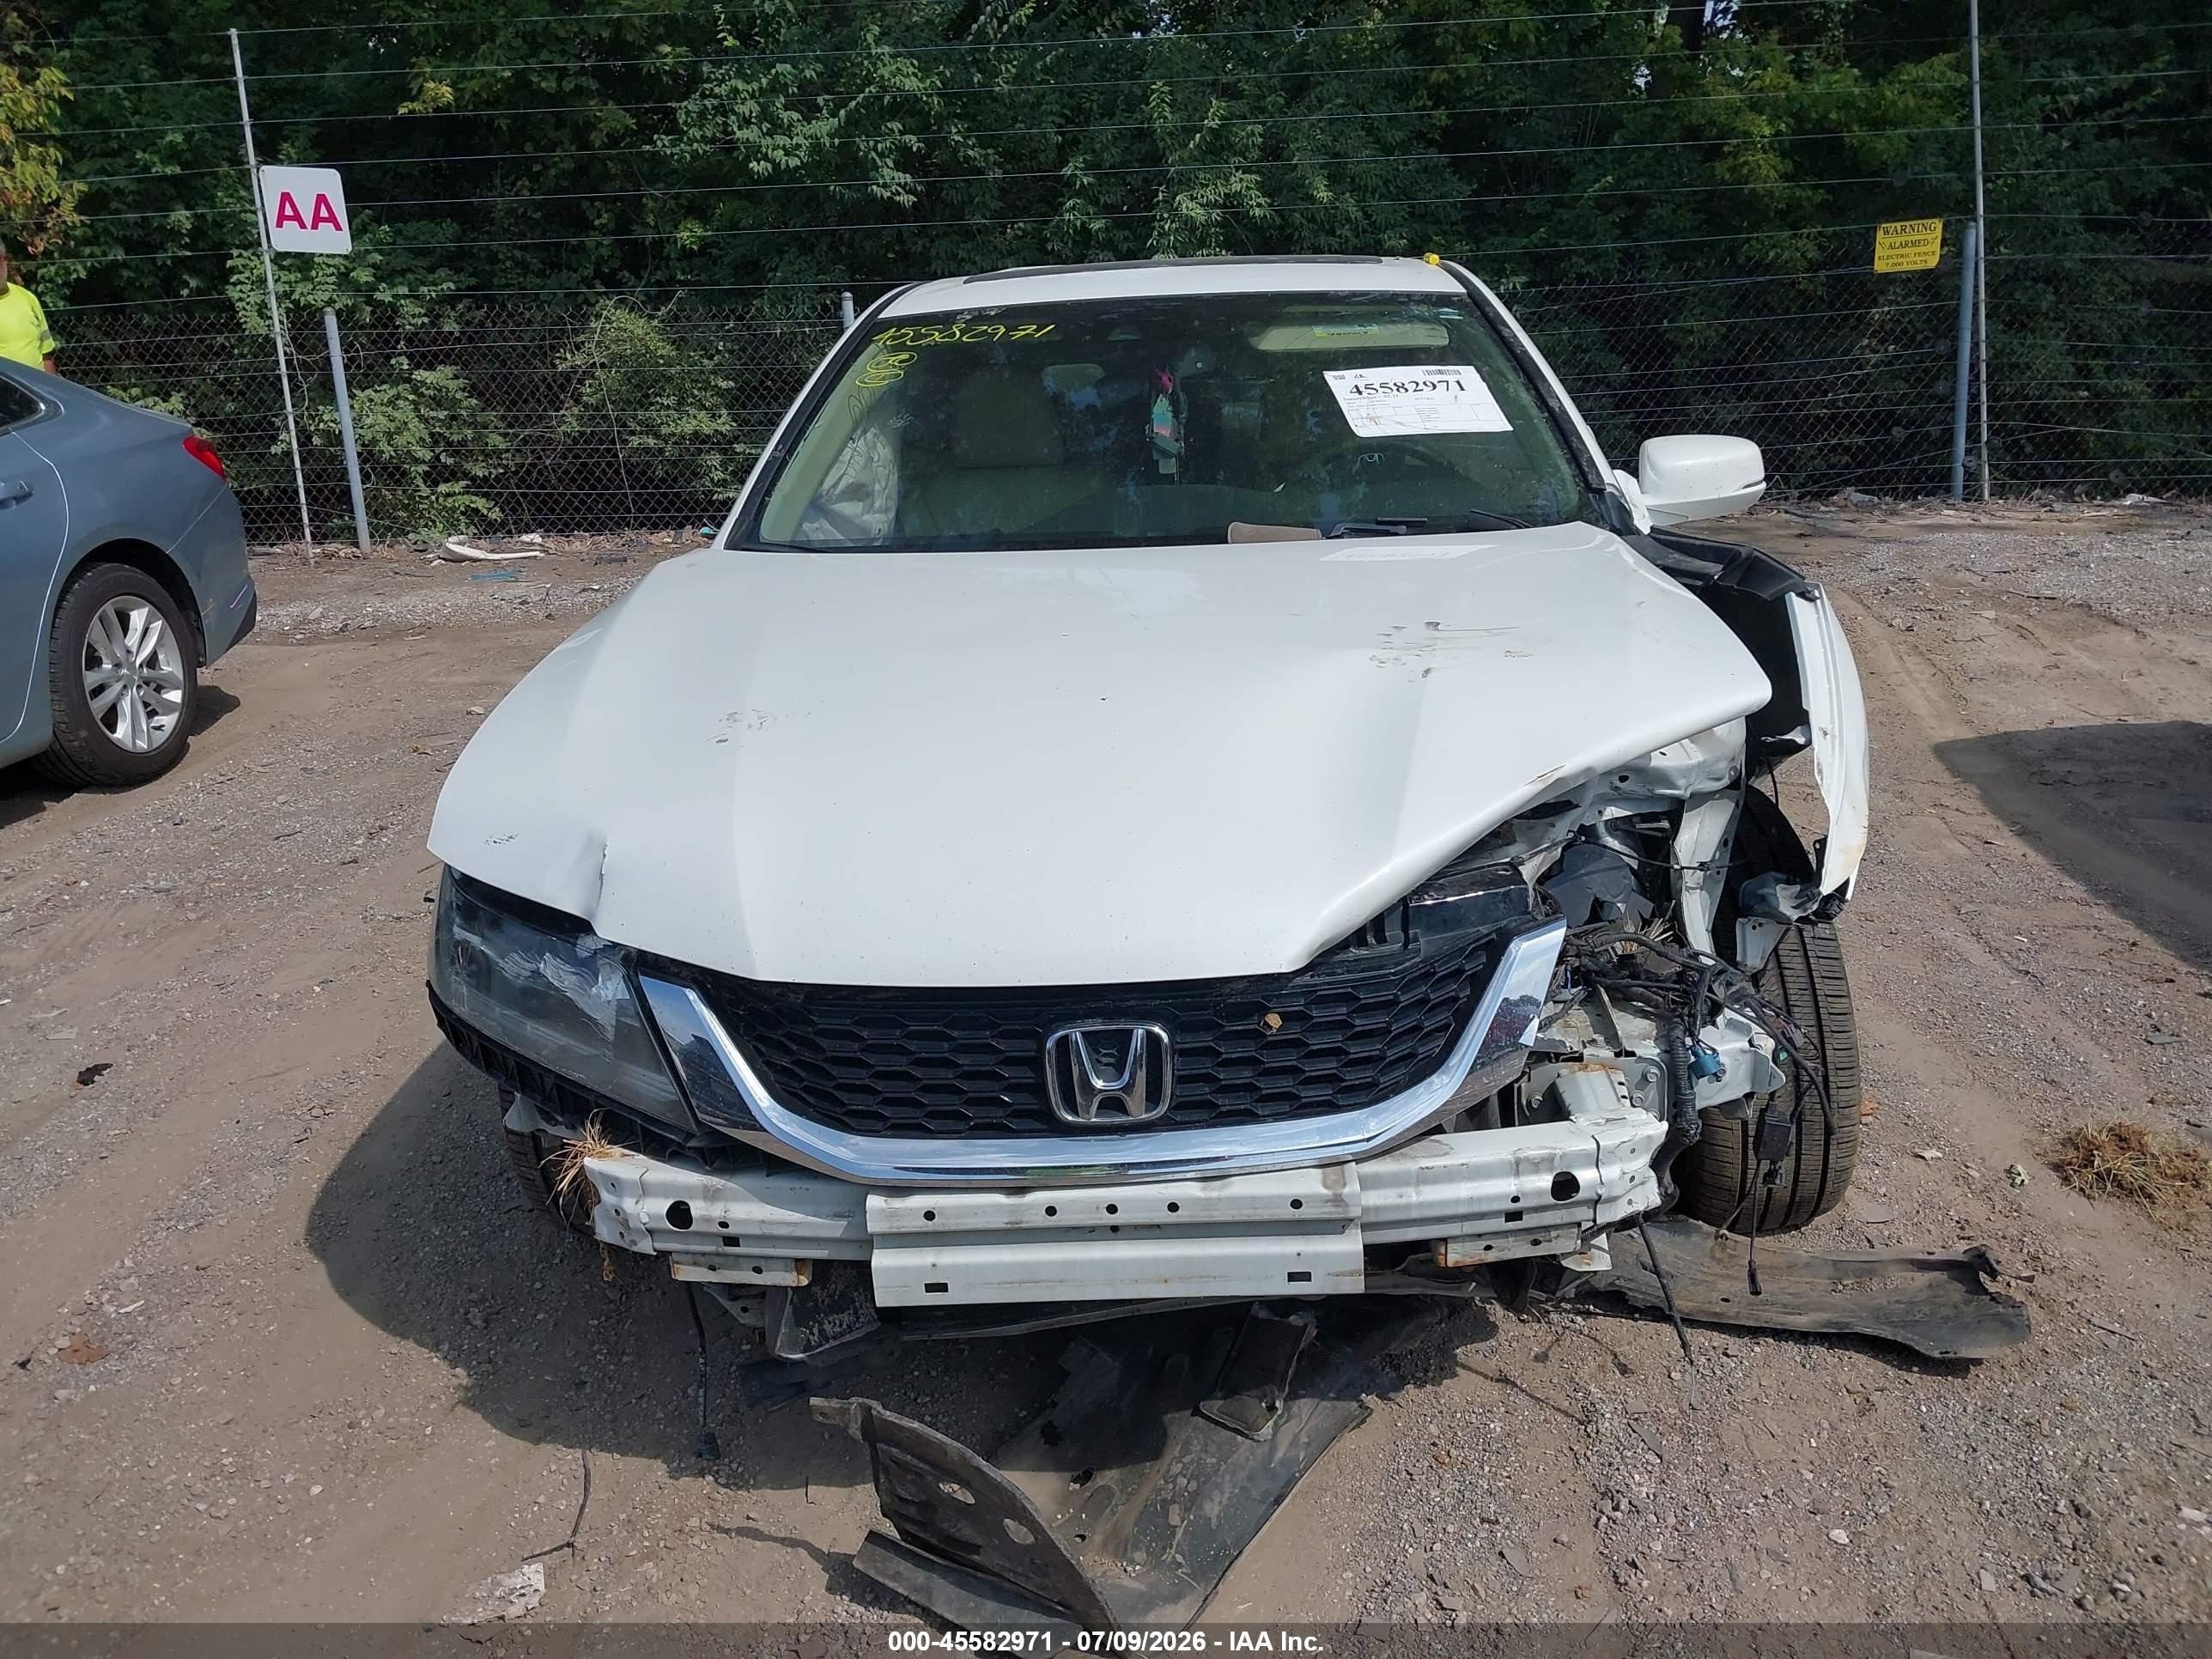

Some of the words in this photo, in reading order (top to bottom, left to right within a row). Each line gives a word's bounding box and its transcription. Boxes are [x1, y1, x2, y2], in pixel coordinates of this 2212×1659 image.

[275, 191, 343, 232] AA
[1882, 222, 1937, 235] WARNING
[1887, 239, 1929, 250] ALARMED
[1878, 252, 1911, 261] ELECTRIC
[872, 324, 1056, 345] 45582971
[1349, 380, 1468, 395] 45582971
